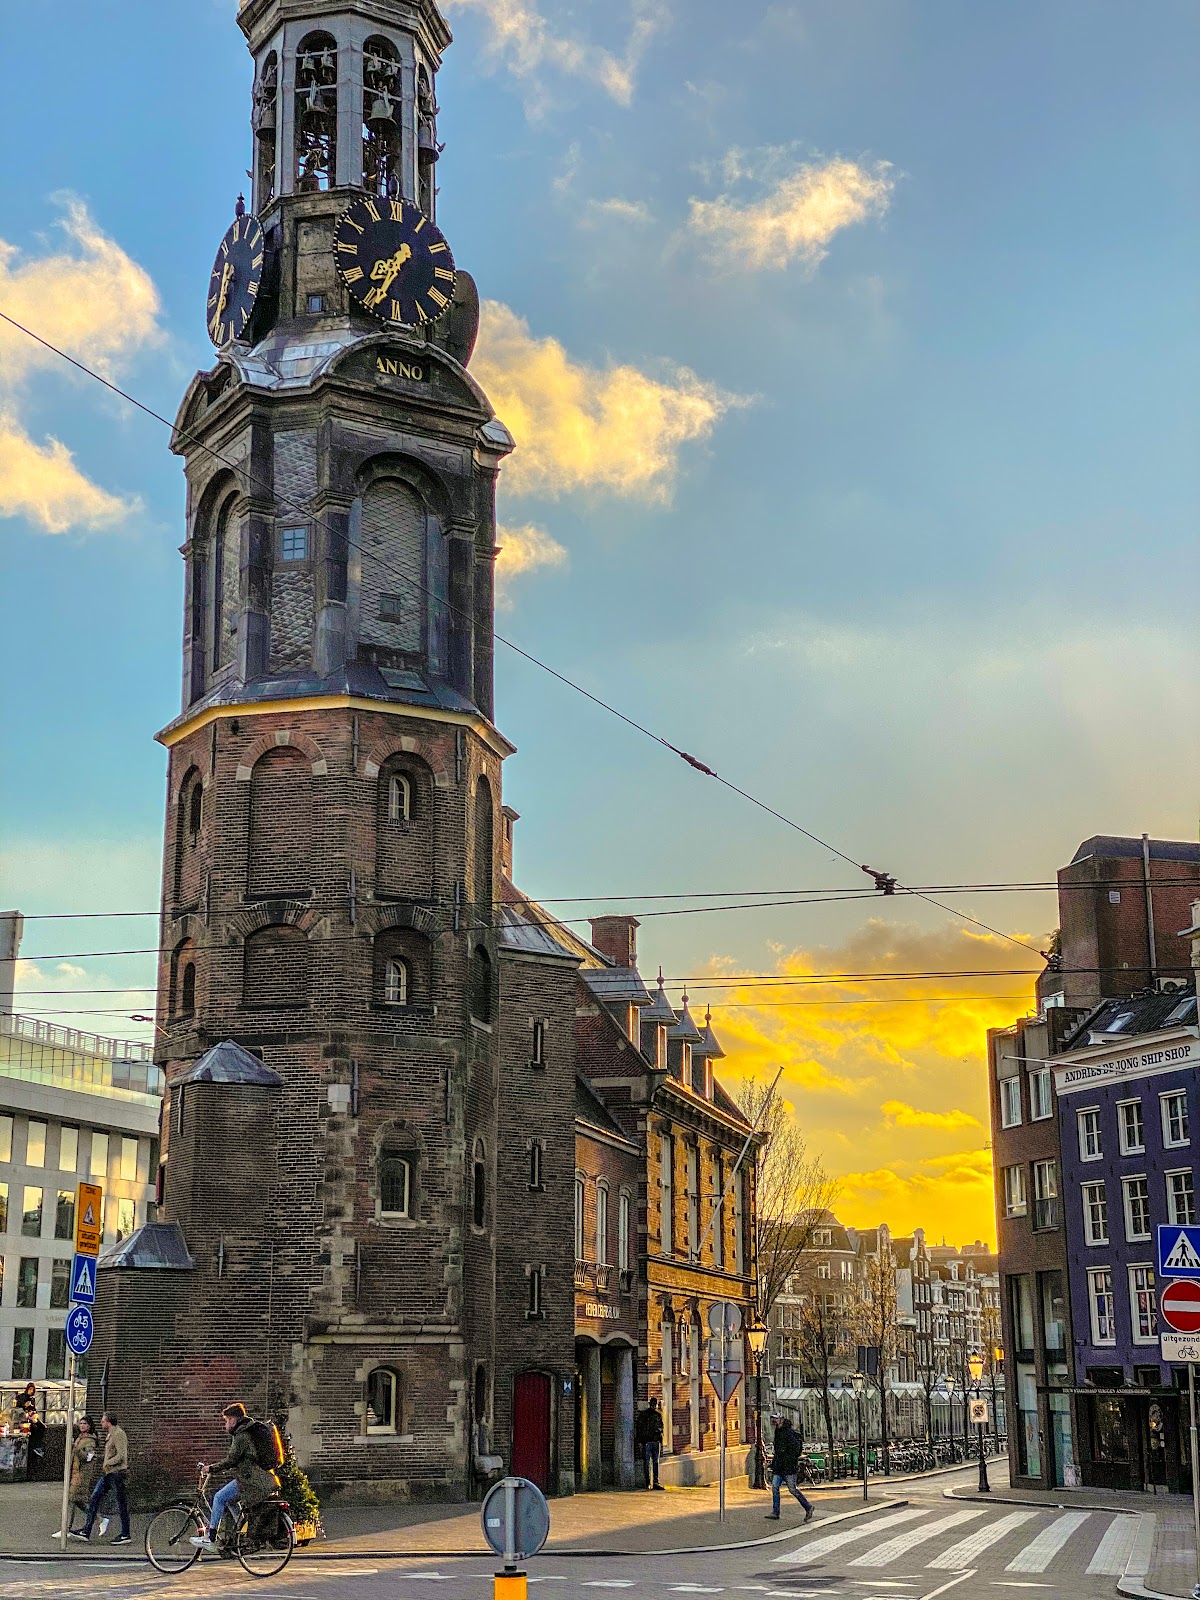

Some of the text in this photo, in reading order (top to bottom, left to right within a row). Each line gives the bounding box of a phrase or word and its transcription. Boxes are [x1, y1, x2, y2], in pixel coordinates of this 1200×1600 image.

[364, 200, 381, 222] XI
[389, 200, 403, 223] XII
[344, 215, 365, 235] X
[414, 216, 426, 233] I
[337, 240, 358, 255] IX
[428, 242, 447, 254] II
[434, 266, 454, 280] III
[391, 299, 401, 321] VI
[415, 300, 428, 321] V
[376, 356, 423, 380] ANNO
[1065, 1064, 1104, 1083] ANDRIES
[1141, 1051, 1165, 1067] SHIP
[1165, 1045, 1191, 1062] SHOP
